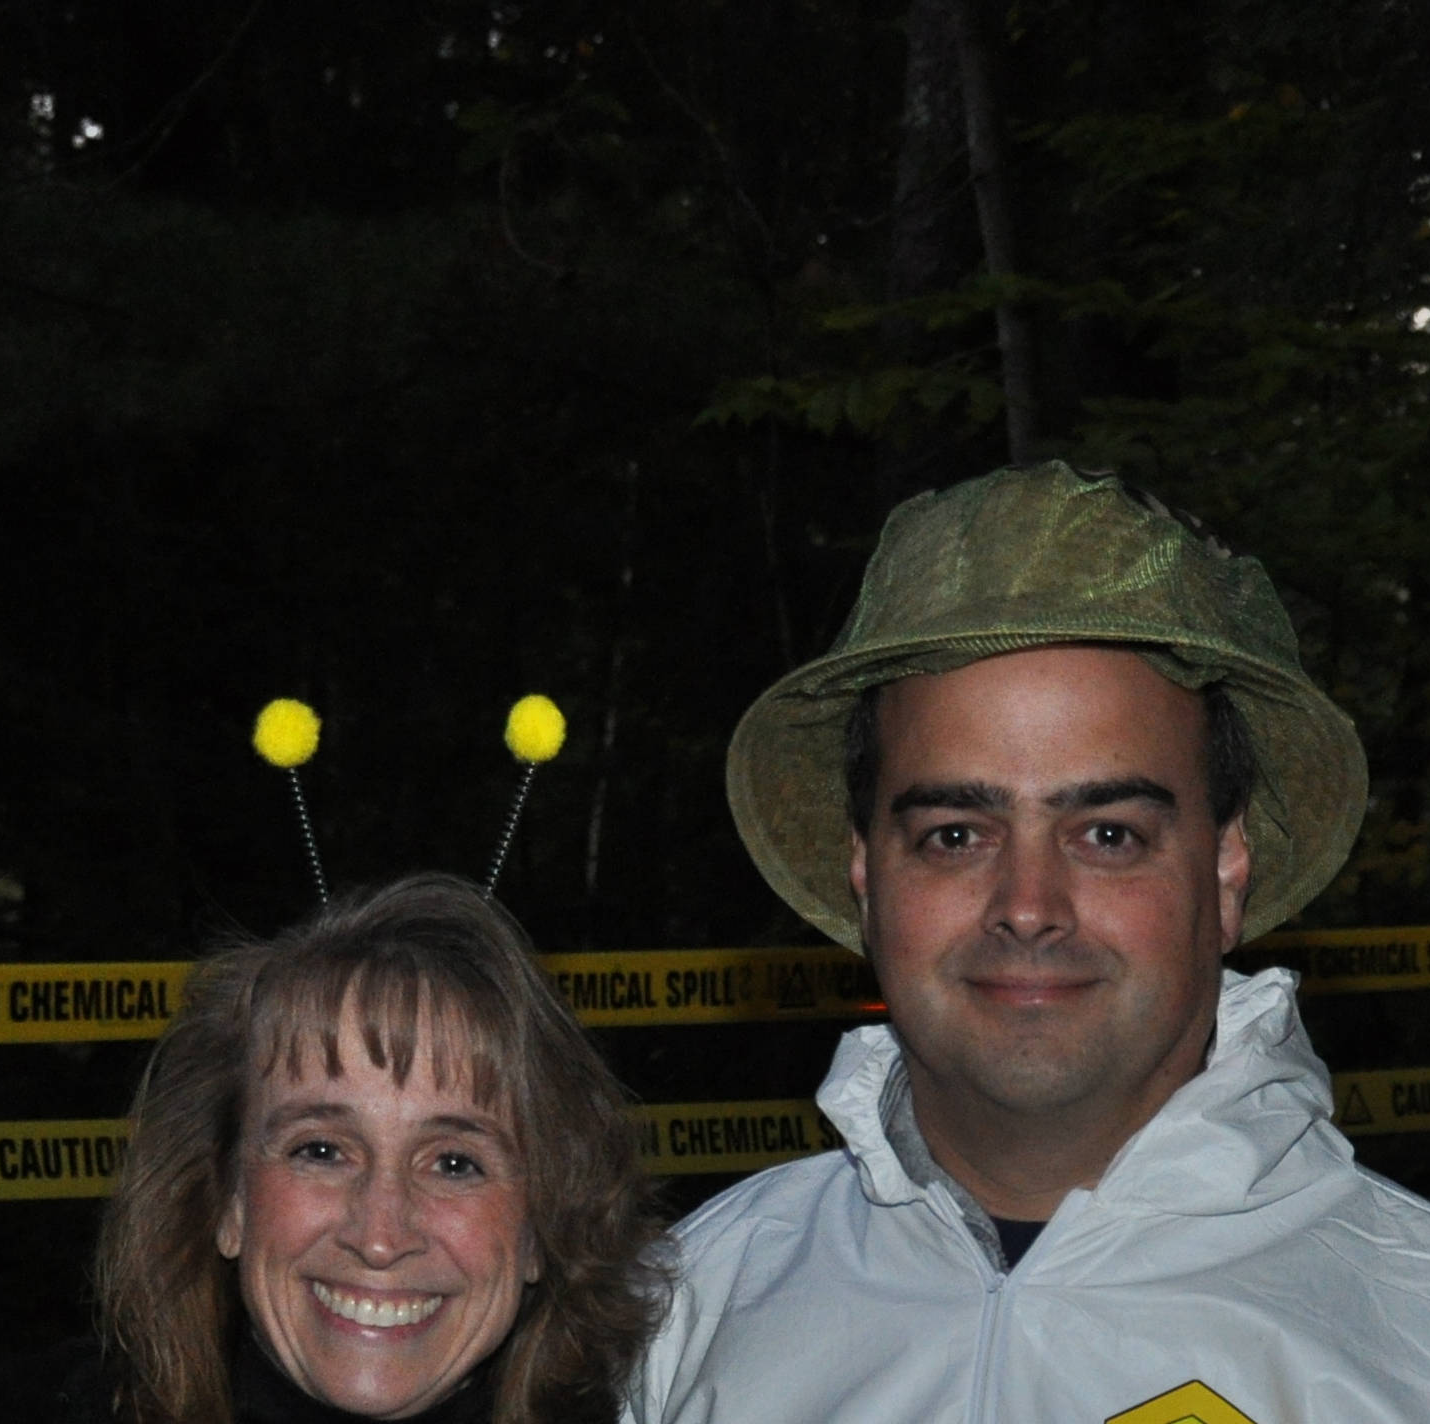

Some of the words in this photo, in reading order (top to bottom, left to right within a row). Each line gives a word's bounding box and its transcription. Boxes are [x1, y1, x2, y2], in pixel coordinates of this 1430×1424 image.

[9, 980, 170, 1021] CHEMICAL
[665, 967, 735, 1007] SPILL
[670, 1115, 810, 1156] CHEMICAL
